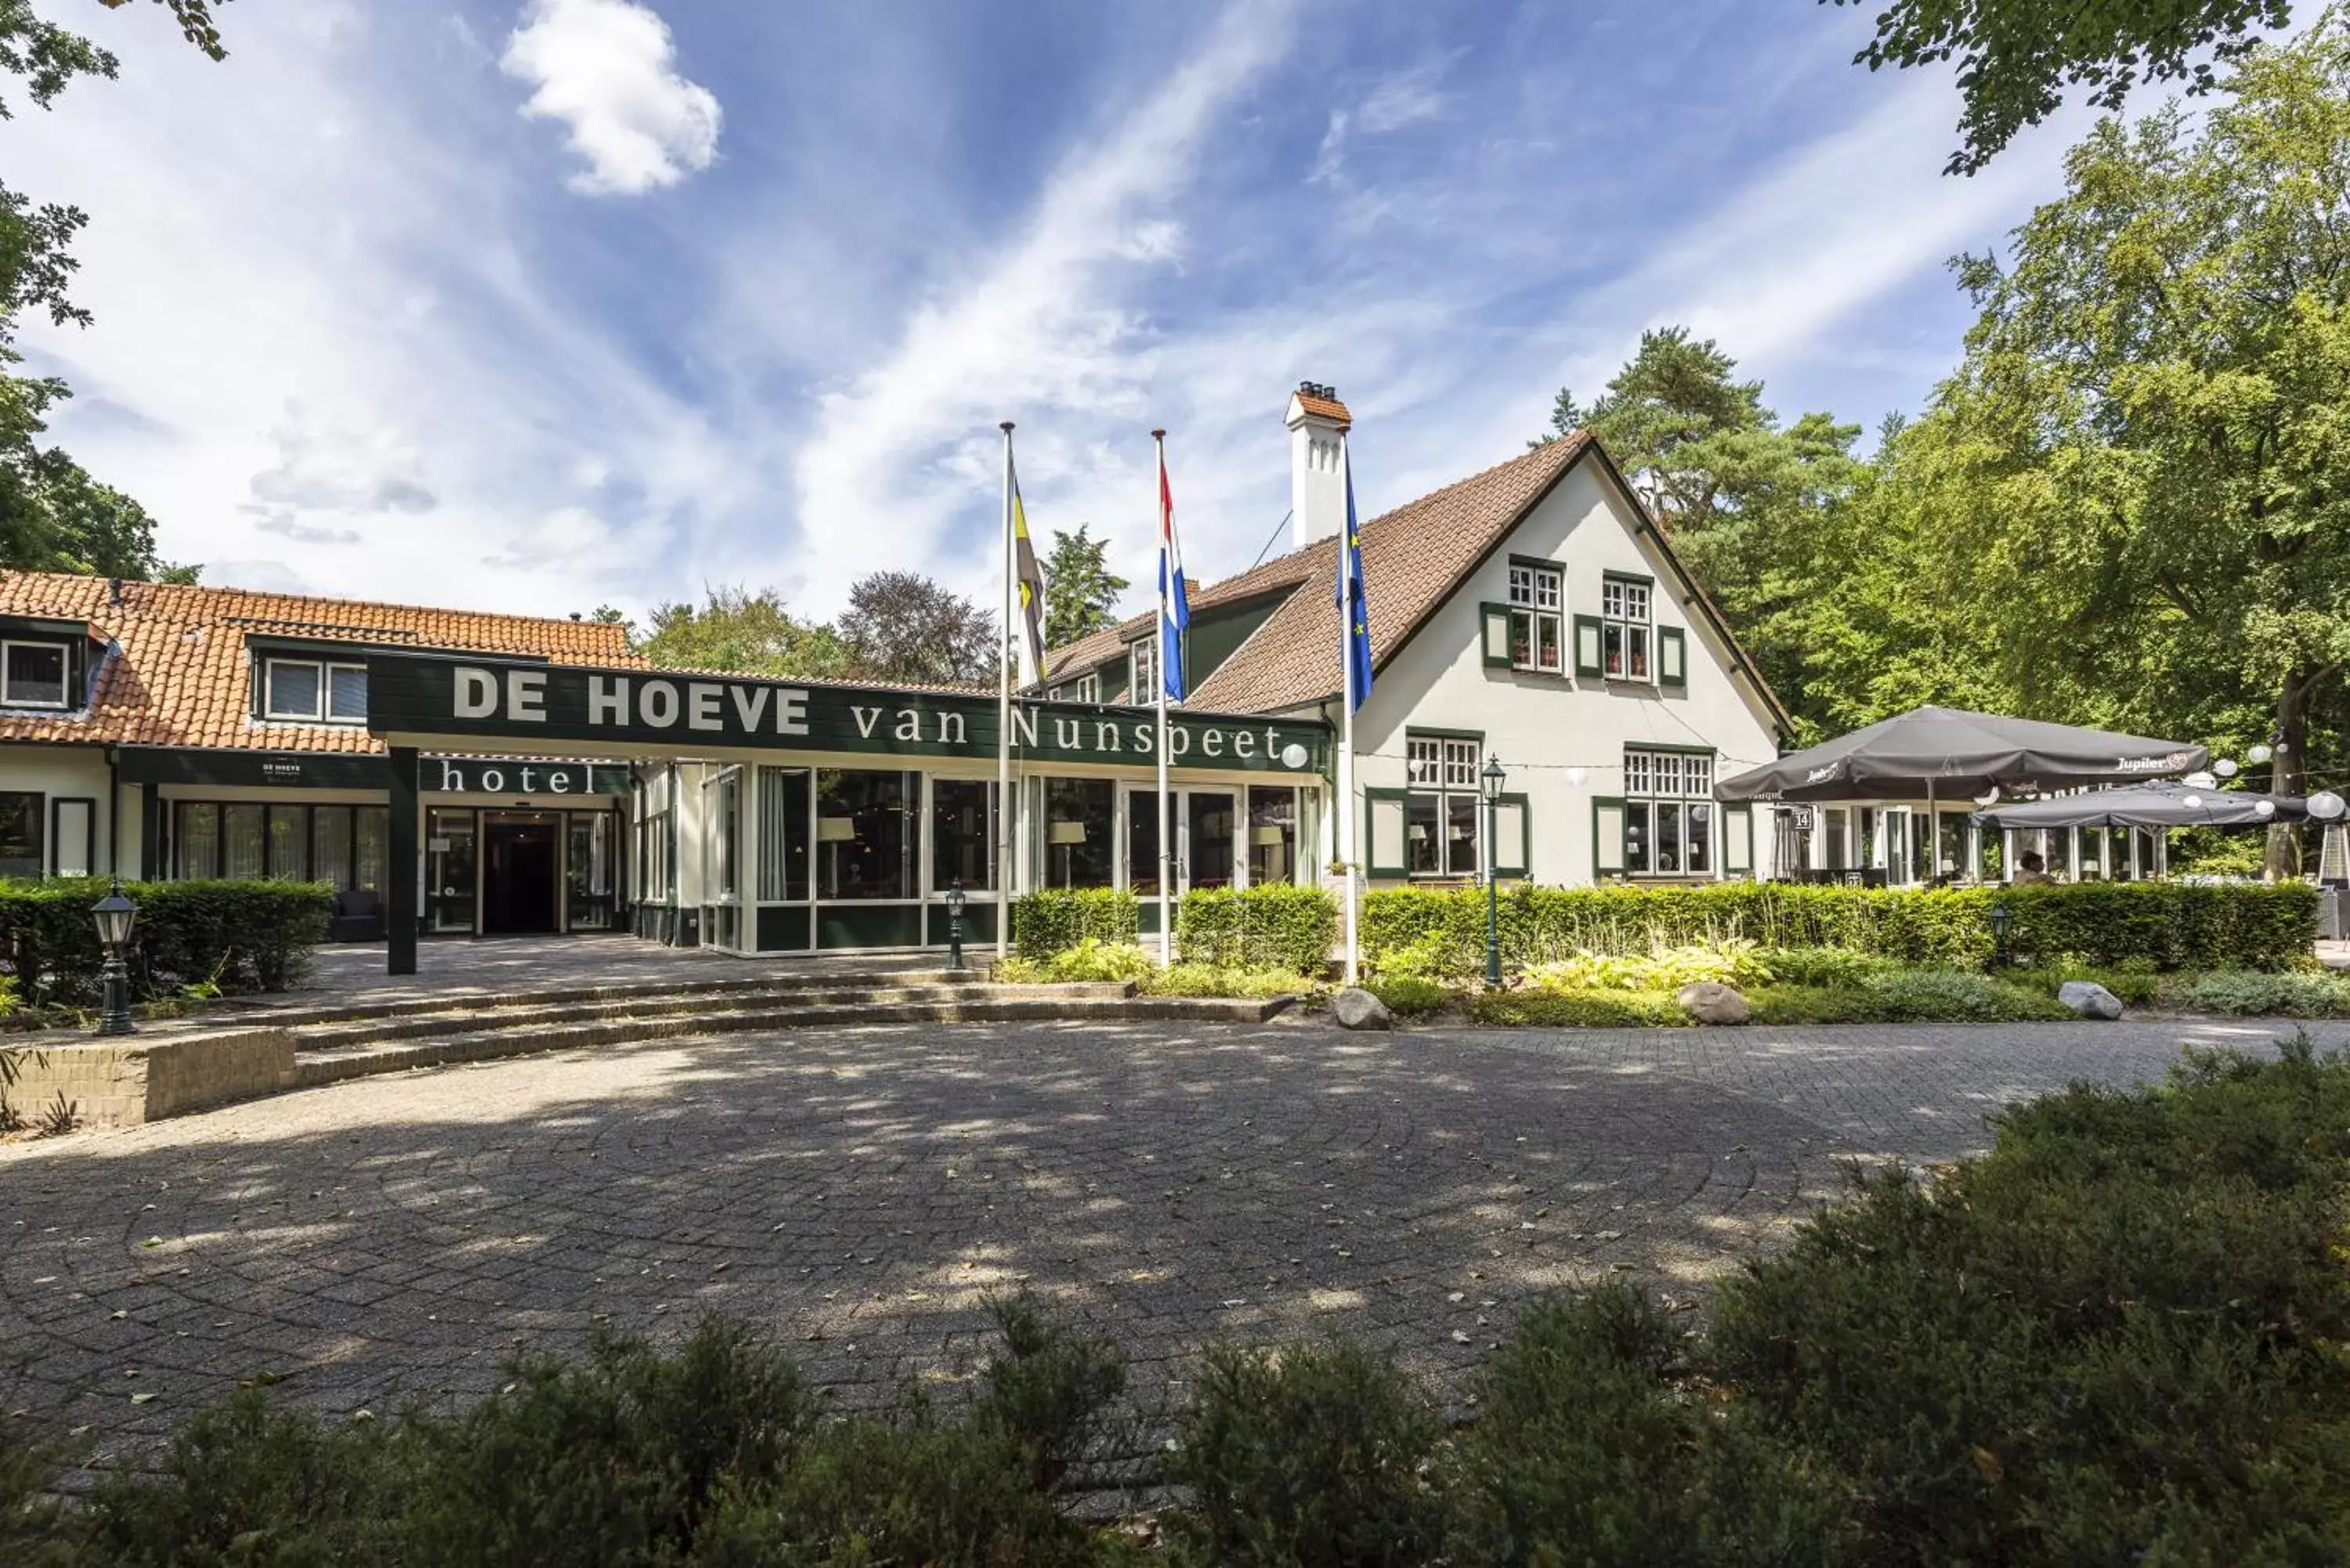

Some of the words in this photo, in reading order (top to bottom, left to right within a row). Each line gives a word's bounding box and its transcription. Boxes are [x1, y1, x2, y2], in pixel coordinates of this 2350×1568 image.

[454, 667, 547, 722] DE
[588, 676, 810, 735] HOEVE
[851, 706, 968, 743] van
[1007, 706, 1281, 765] Nunspeet
[440, 760, 595, 793] hotel
[2117, 757, 2167, 771] Jupiler
